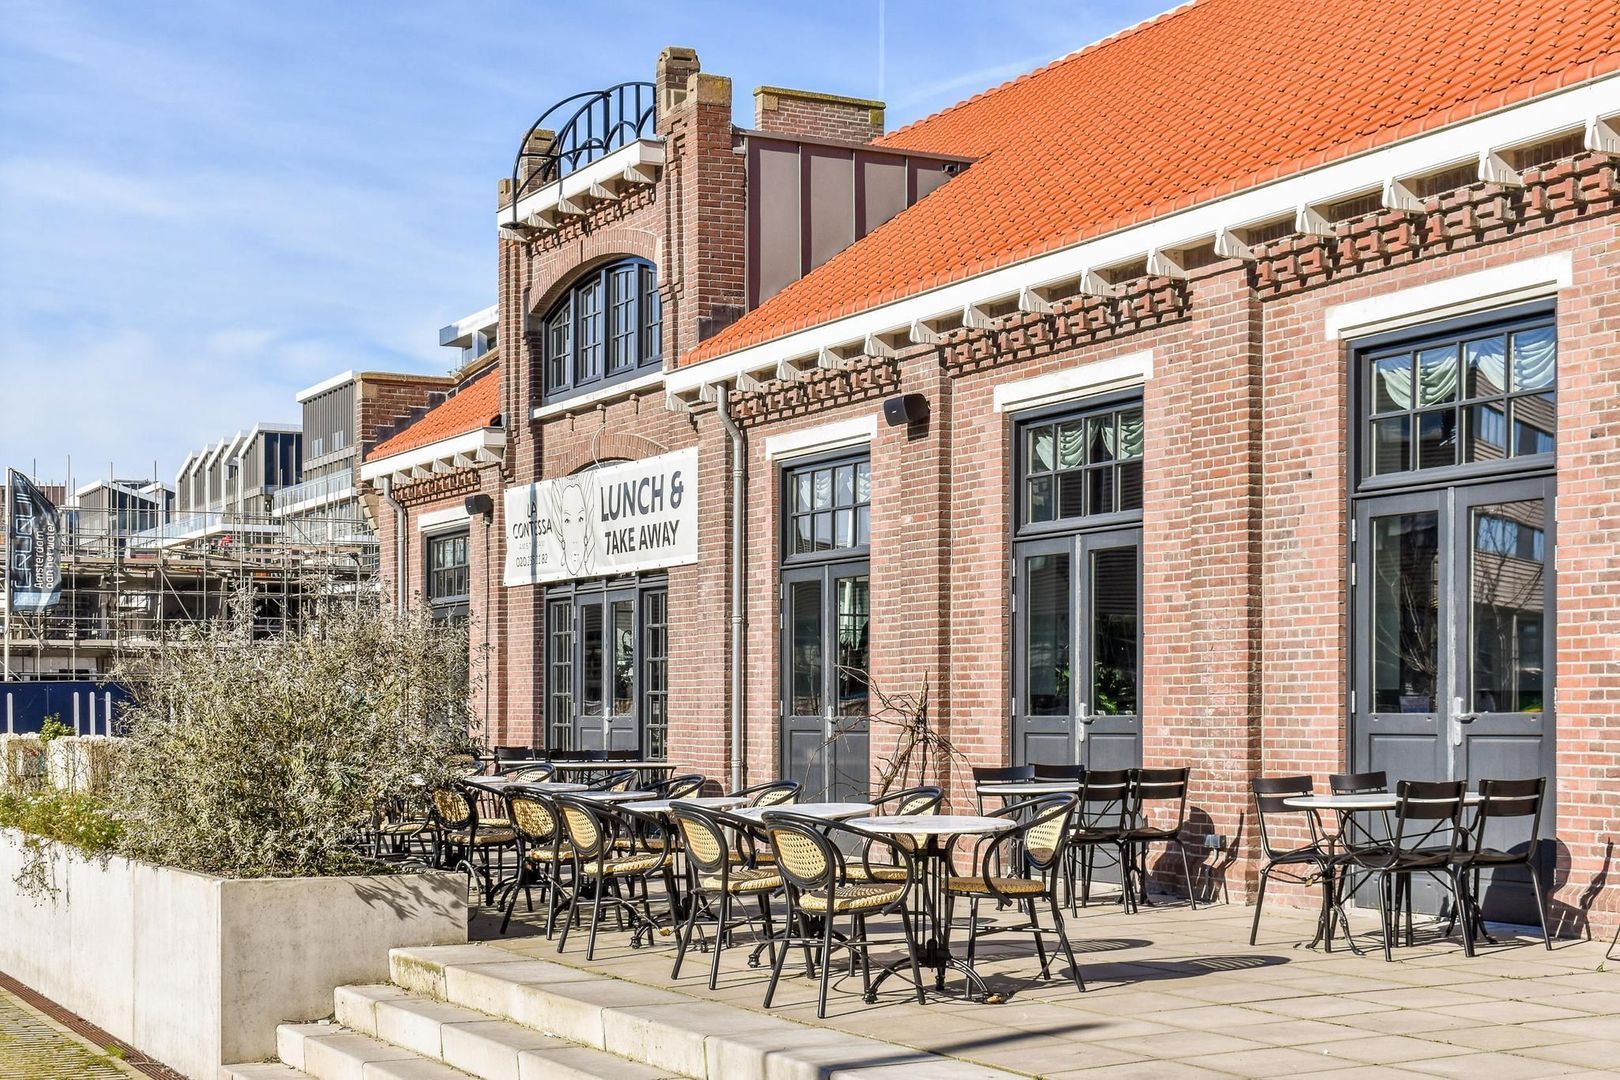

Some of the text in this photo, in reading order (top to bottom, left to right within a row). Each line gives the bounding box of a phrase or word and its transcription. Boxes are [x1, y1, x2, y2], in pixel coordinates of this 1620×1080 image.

[527, 502, 537, 518] LA
[601, 471, 684, 522] LUNCH &
[513, 518, 553, 539] CONTESSA
[605, 520, 680, 555] TAKE AWAY
[33, 530, 44, 589] Amsterdam
[46, 521, 55, 589] aan het water
